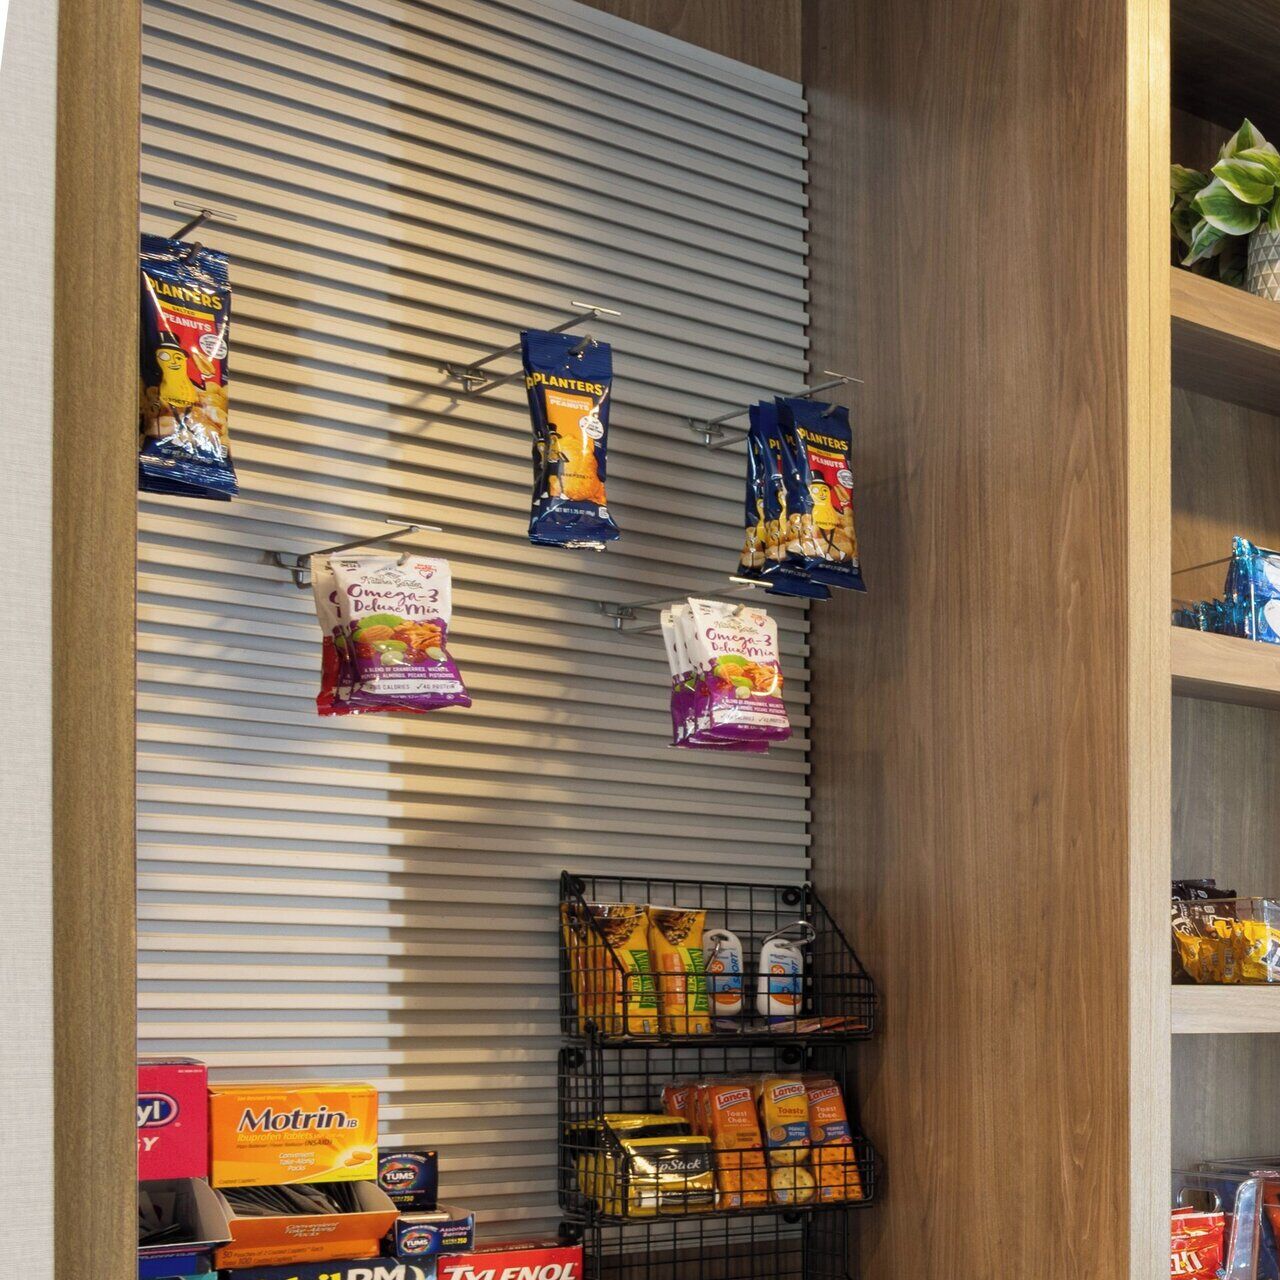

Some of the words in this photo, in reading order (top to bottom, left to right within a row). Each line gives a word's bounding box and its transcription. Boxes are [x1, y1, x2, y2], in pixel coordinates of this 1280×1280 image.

[148, 277, 222, 310] PLANTERS
[163, 311, 212, 332] PEANUTS
[533, 373, 603, 396] PLANTERS
[550, 400, 590, 411] PEANUTS
[799, 428, 848, 450] PLANTERS
[811, 455, 845, 468] PEANUTS
[347, 584, 439, 605] Omega-3
[354, 599, 401, 613] Deluxe
[407, 603, 439, 616] Mix
[706, 628, 772, 649] Omega-3
[712, 642, 745, 655] Deluxe
[717, 1090, 750, 1106] Lance
[773, 1084, 803, 1099] Lance
[238, 1106, 346, 1132] Motrin
[777, 1107, 804, 1115] Toasty
[237, 1131, 281, 1143] Ibuprofen
[283, 1131, 314, 1140] Tablets
[385, 1172, 415, 1180] TUMS
[406, 1239, 428, 1247] TUMS
